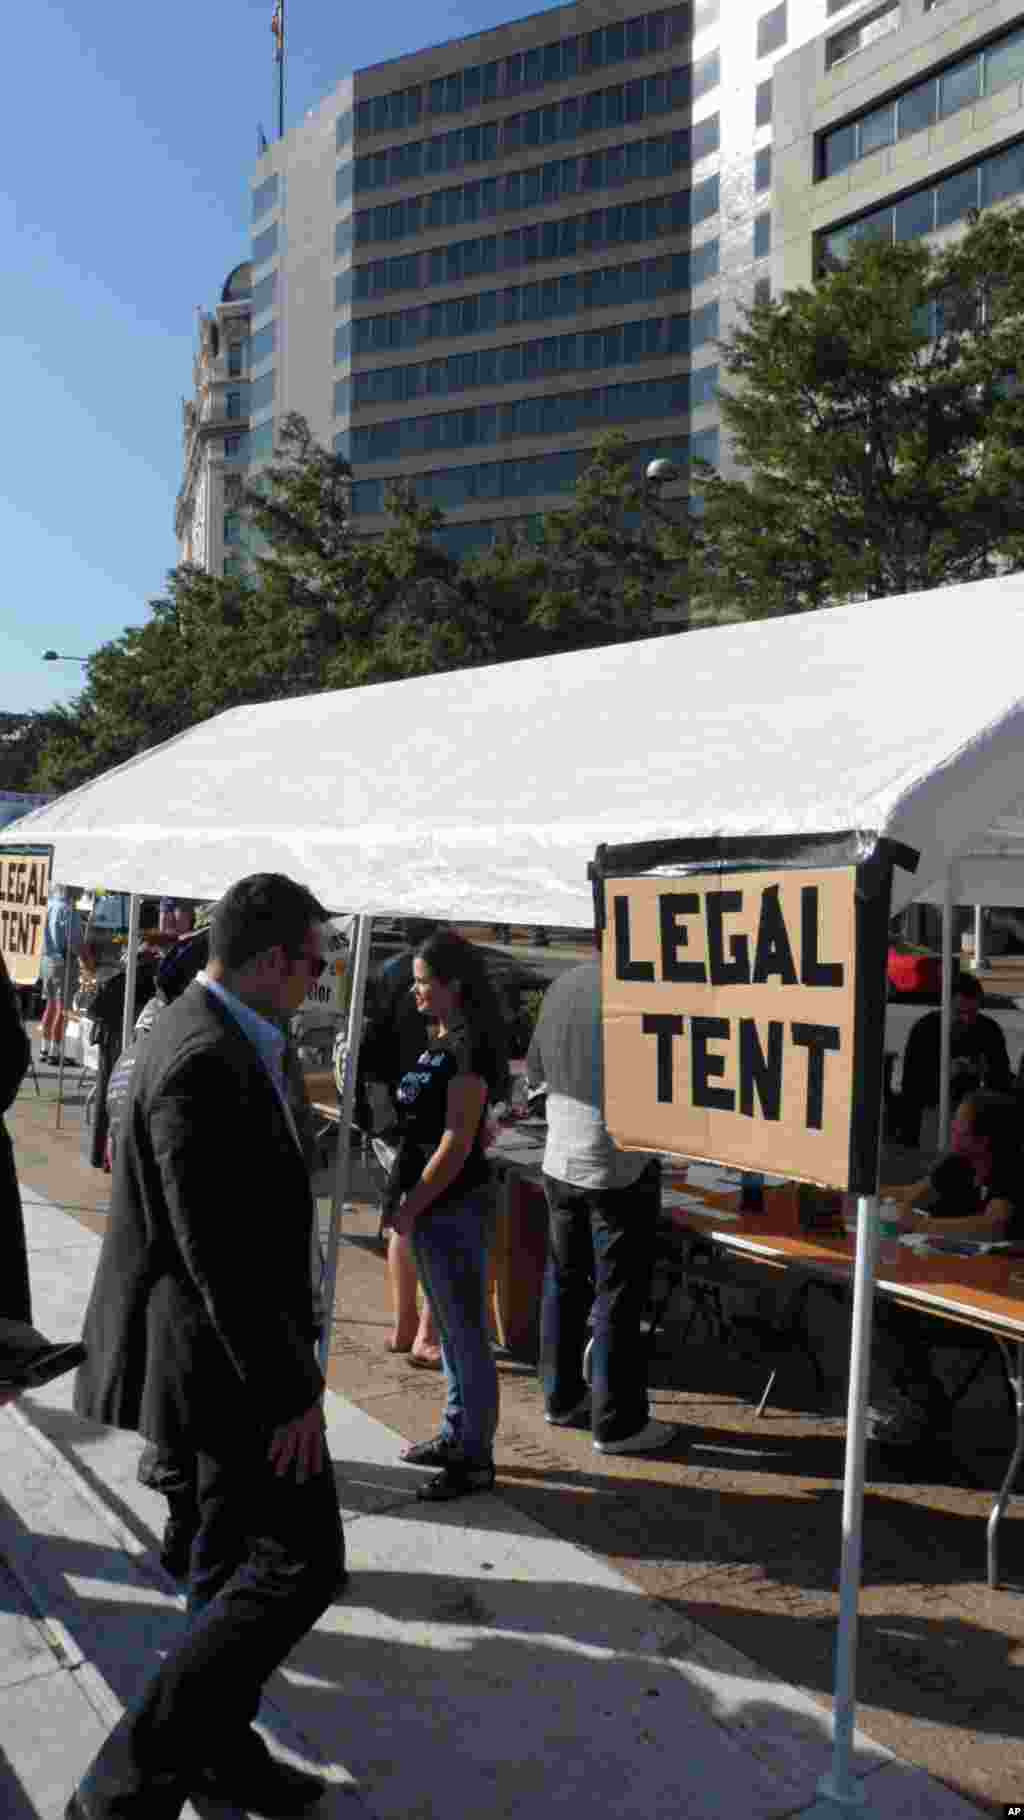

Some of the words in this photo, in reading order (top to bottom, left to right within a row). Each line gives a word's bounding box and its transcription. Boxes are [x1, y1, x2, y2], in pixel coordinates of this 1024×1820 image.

[0, 862, 47, 906] LEGAL
[1, 910, 41, 955] TENT
[614, 884, 844, 987] LEGAL
[641, 1013, 841, 1130] TENT
